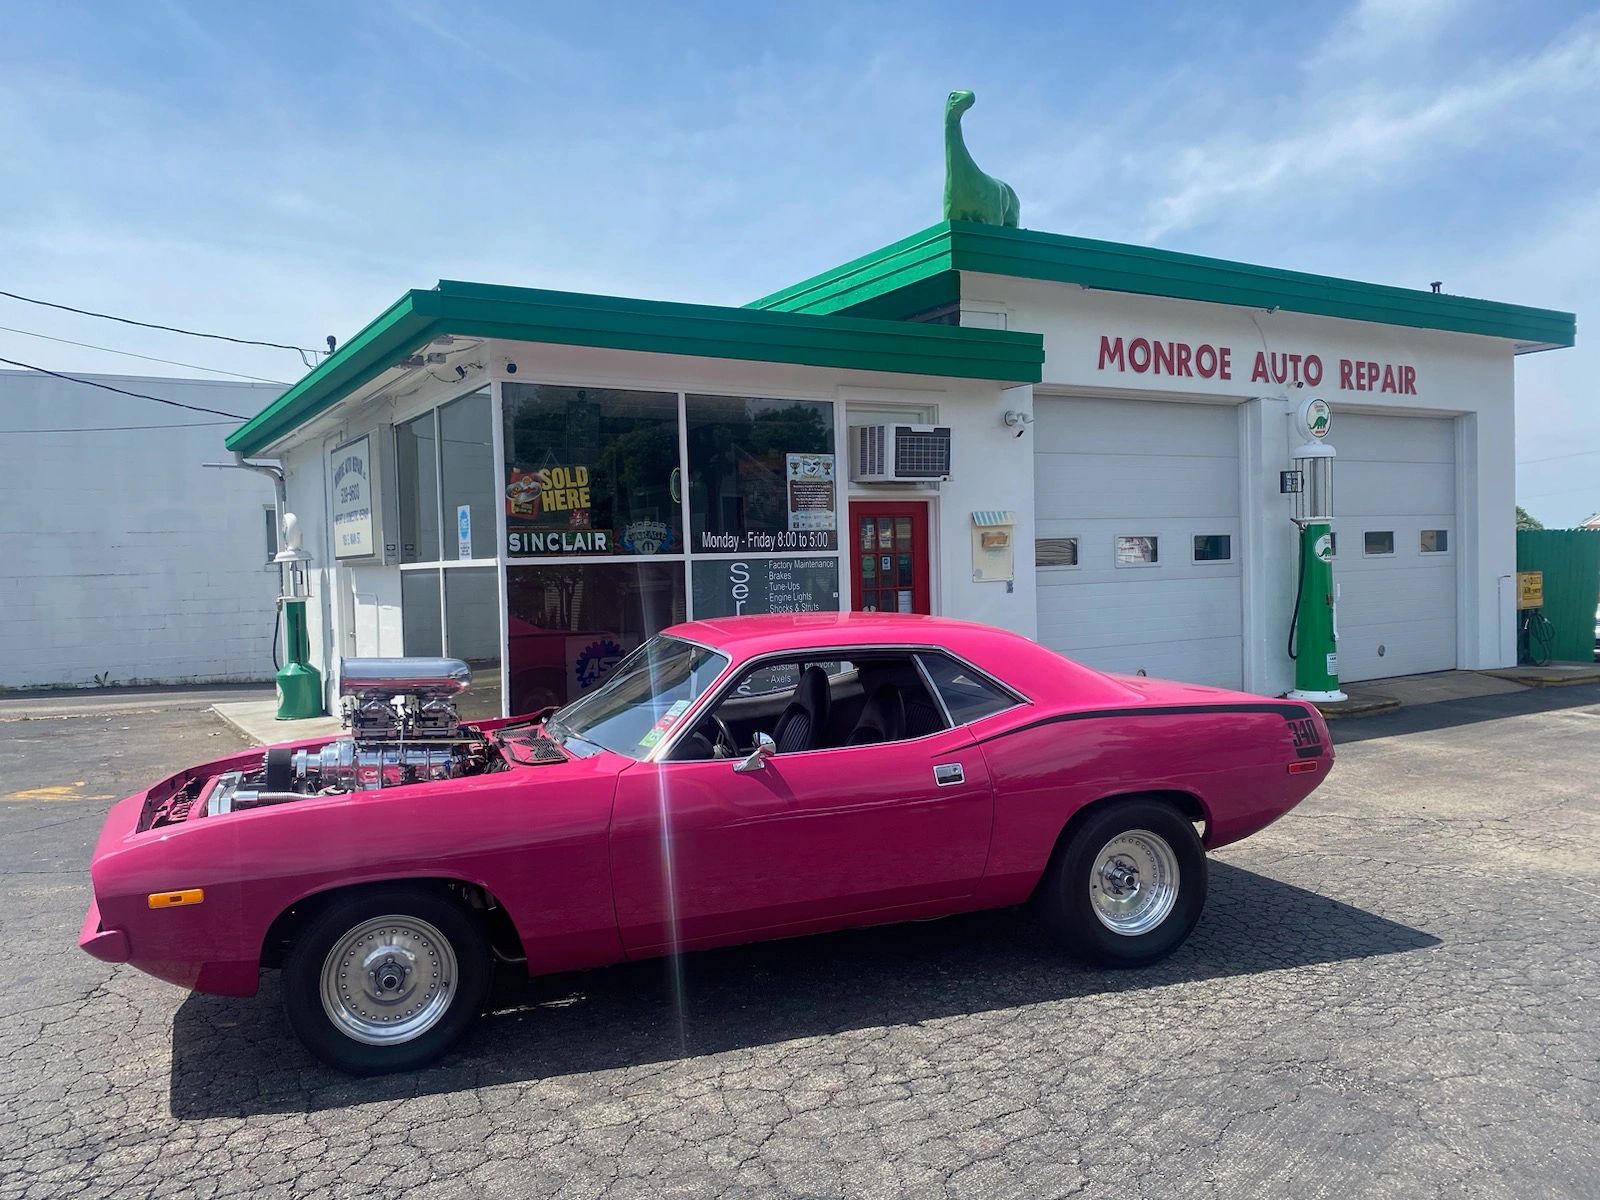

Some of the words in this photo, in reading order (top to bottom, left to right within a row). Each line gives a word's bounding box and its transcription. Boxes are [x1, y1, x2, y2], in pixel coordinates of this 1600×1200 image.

[1097, 335, 1232, 380] MONROE
[1250, 351, 1323, 387] AUTO
[1339, 359, 1418, 395] REPAIR
[541, 465, 589, 491] SOLD
[541, 487, 591, 513] HERE
[508, 531, 607, 552] SINCLAIR
[701, 531, 739, 552] Monday
[747, 531, 775, 552] Friday
[777, 531, 797, 547] 8:00
[798, 532, 808, 548] to
[809, 531, 828, 547] 5:00
[768, 559, 793, 571] Factory
[794, 559, 834, 569] Maintenance
[768, 571, 792, 581] Brakes
[769, 581, 801, 592] Tune-Ups
[769, 592, 792, 604] Engine
[793, 591, 813, 603] Lights
[769, 604, 793, 614] Shocks
[794, 603, 800, 612] &
[801, 602, 820, 613] Struts
[770, 675, 792, 684] Axels
[1287, 719, 1321, 747] 340
